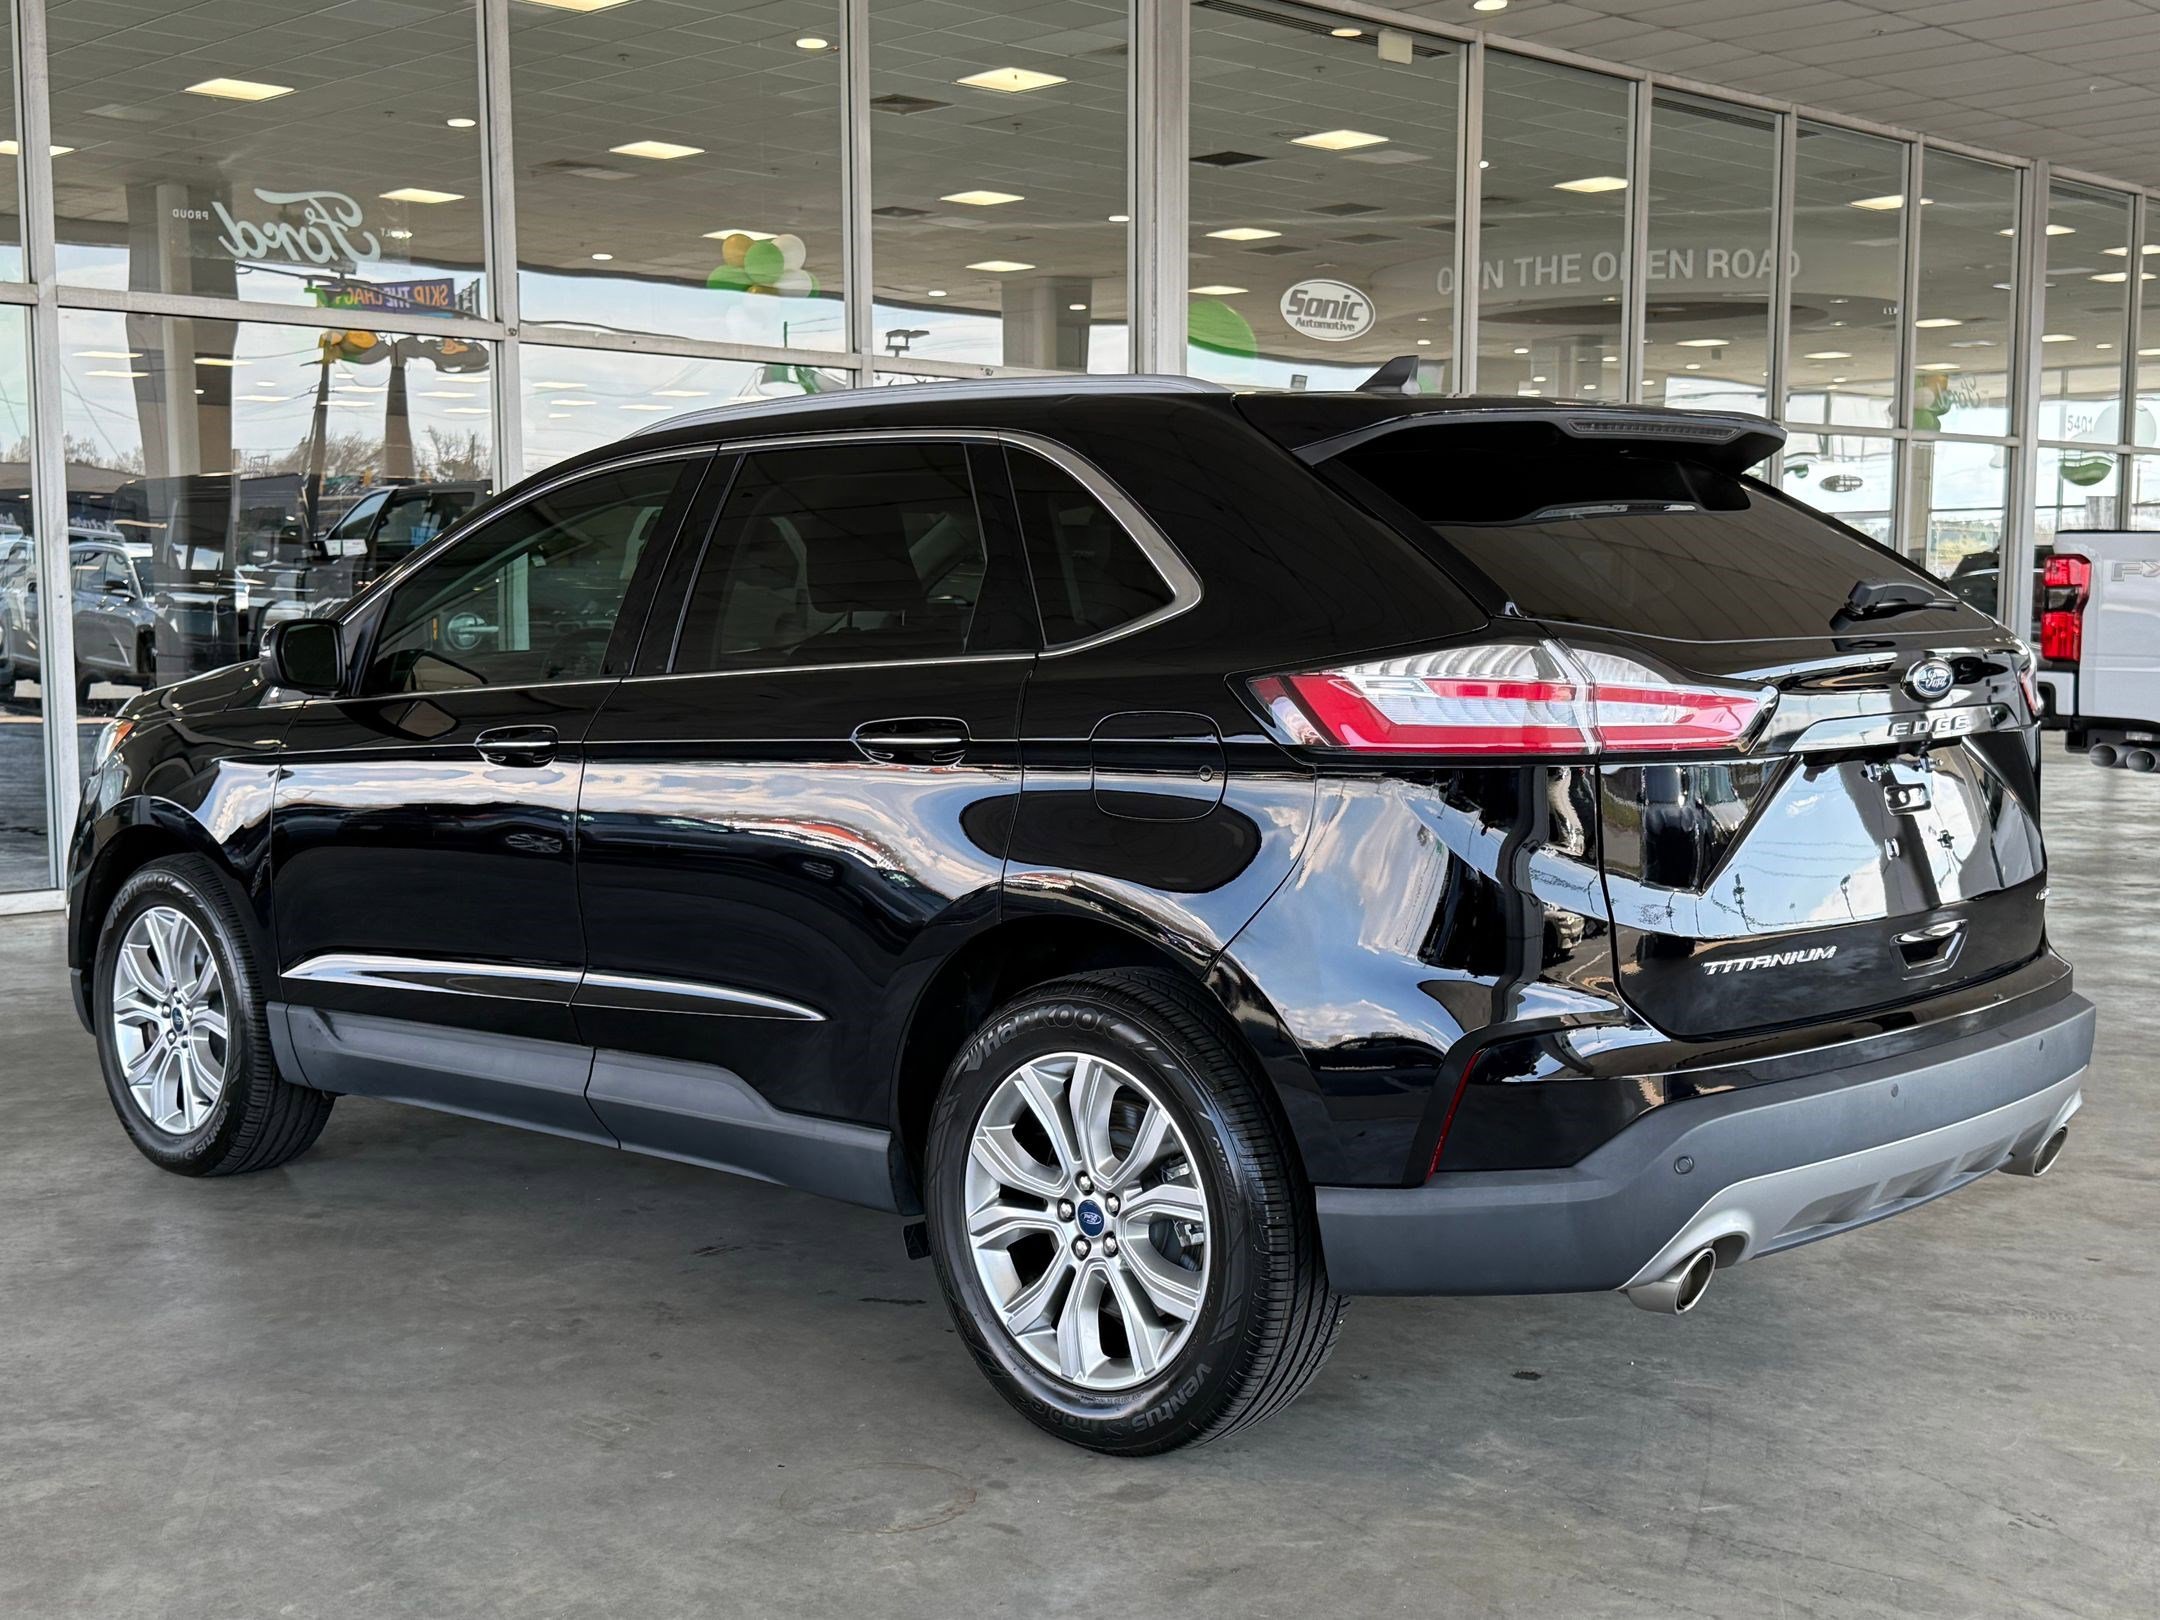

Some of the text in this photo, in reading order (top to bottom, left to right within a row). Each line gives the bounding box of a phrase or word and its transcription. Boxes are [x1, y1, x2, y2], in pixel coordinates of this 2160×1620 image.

[1513, 252, 1581, 287] THE
[1286, 288, 1363, 322] Sonic
[1295, 315, 1355, 333] Automotive
[2067, 414, 2094, 434] 5401
[1888, 715, 1969, 736] EDGE
[1702, 945, 1837, 975] TITANIUM
